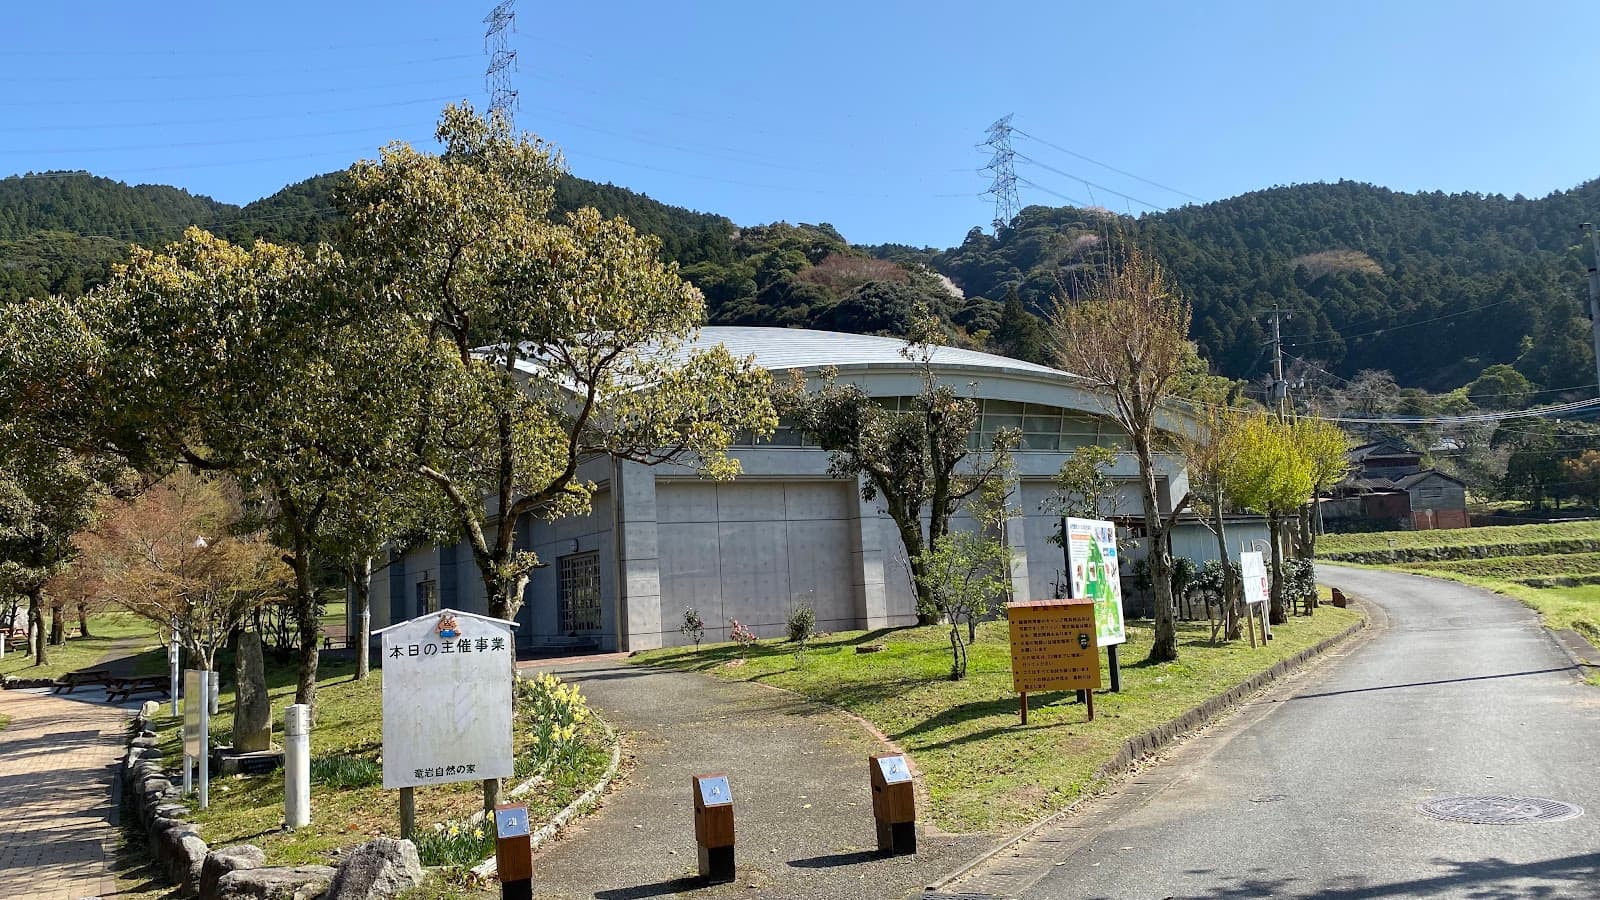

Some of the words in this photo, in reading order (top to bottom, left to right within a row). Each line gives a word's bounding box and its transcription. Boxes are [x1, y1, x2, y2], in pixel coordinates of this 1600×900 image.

[389, 637, 505, 659] 本日の主催事業
